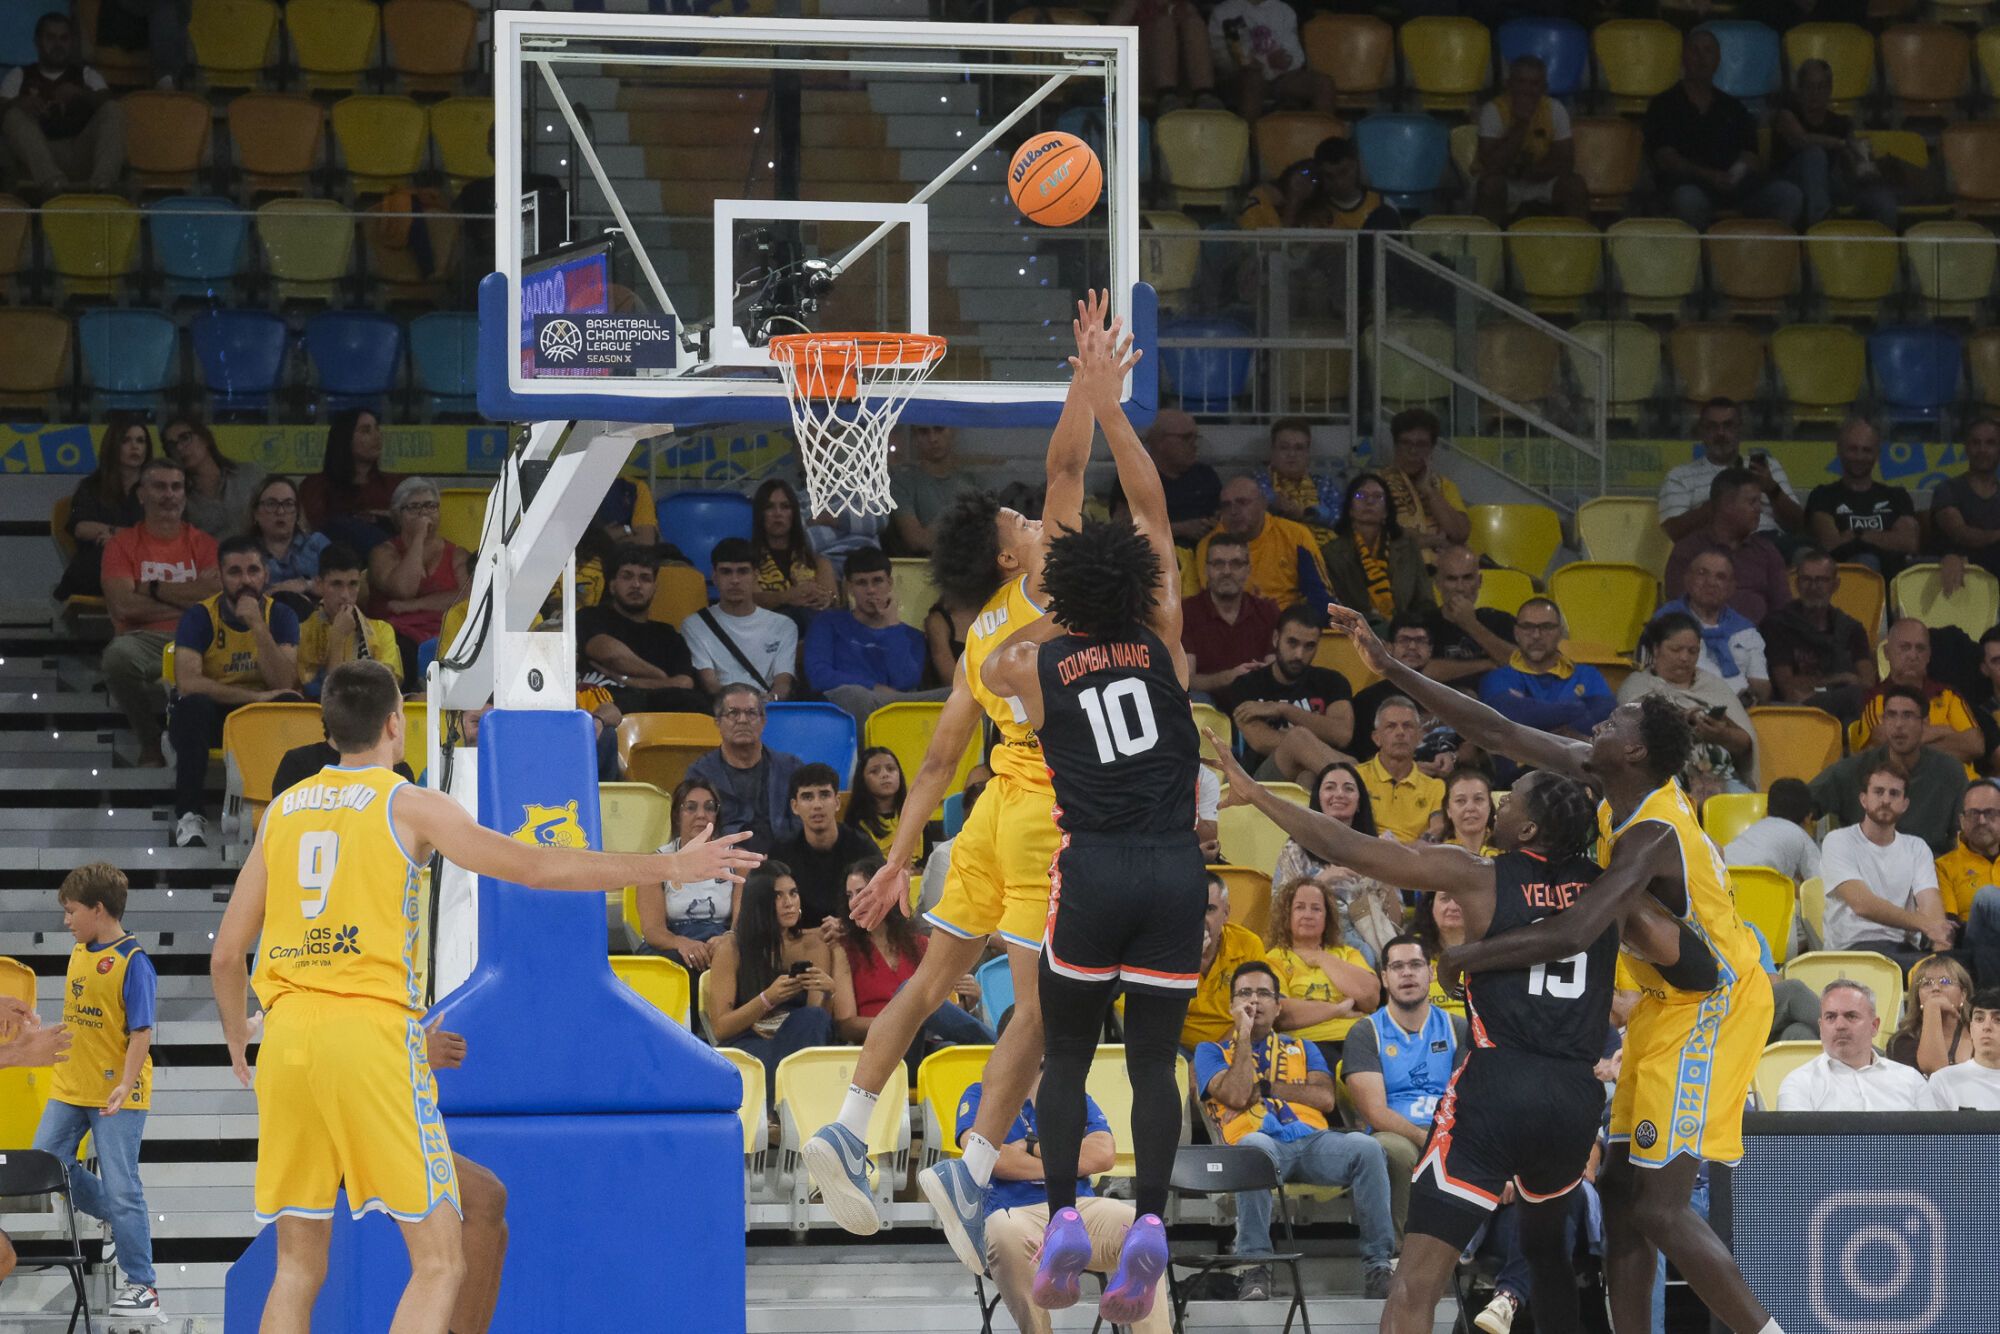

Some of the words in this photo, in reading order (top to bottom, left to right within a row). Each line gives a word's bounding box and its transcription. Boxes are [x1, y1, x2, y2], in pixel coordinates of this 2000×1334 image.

[1012, 140, 1063, 182] Wilson
[585, 319, 661, 329] BASKETBALL
[585, 329, 671, 341] CHAMPIONS
[586, 341, 632, 351] LEAGUE
[586, 354, 623, 363] SEASON
[624, 354, 633, 363] X
[1854, 519, 1879, 529] AIG
[1057, 644, 1112, 686] DOUMBIA
[1110, 643, 1150, 669] NIANG
[1078, 677, 1159, 764] 10
[298, 830, 339, 919] 9
